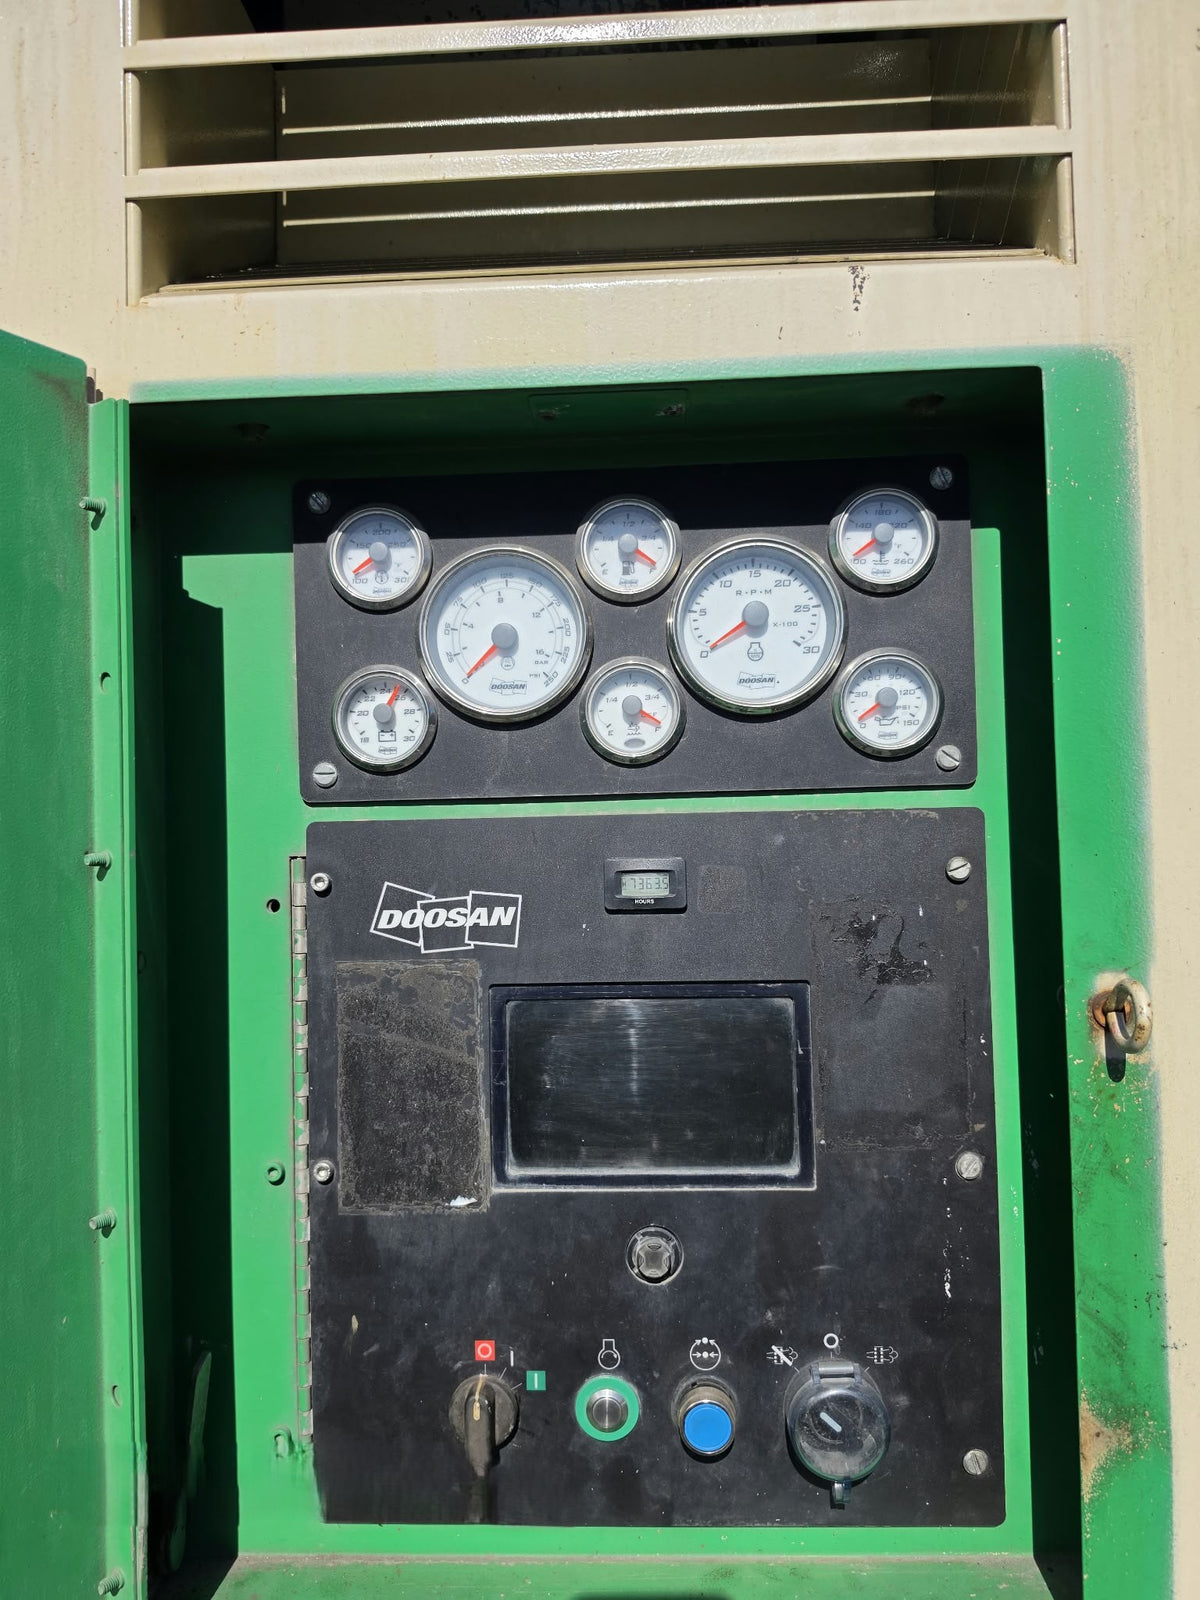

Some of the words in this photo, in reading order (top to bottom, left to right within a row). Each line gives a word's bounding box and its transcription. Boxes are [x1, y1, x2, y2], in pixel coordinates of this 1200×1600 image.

[794, 604, 810, 612] 25
[562, 618, 571, 636] 200
[802, 646, 820, 654] 30
[544, 671, 558, 688] 250
[378, 906, 516, 928] DOOSAN
